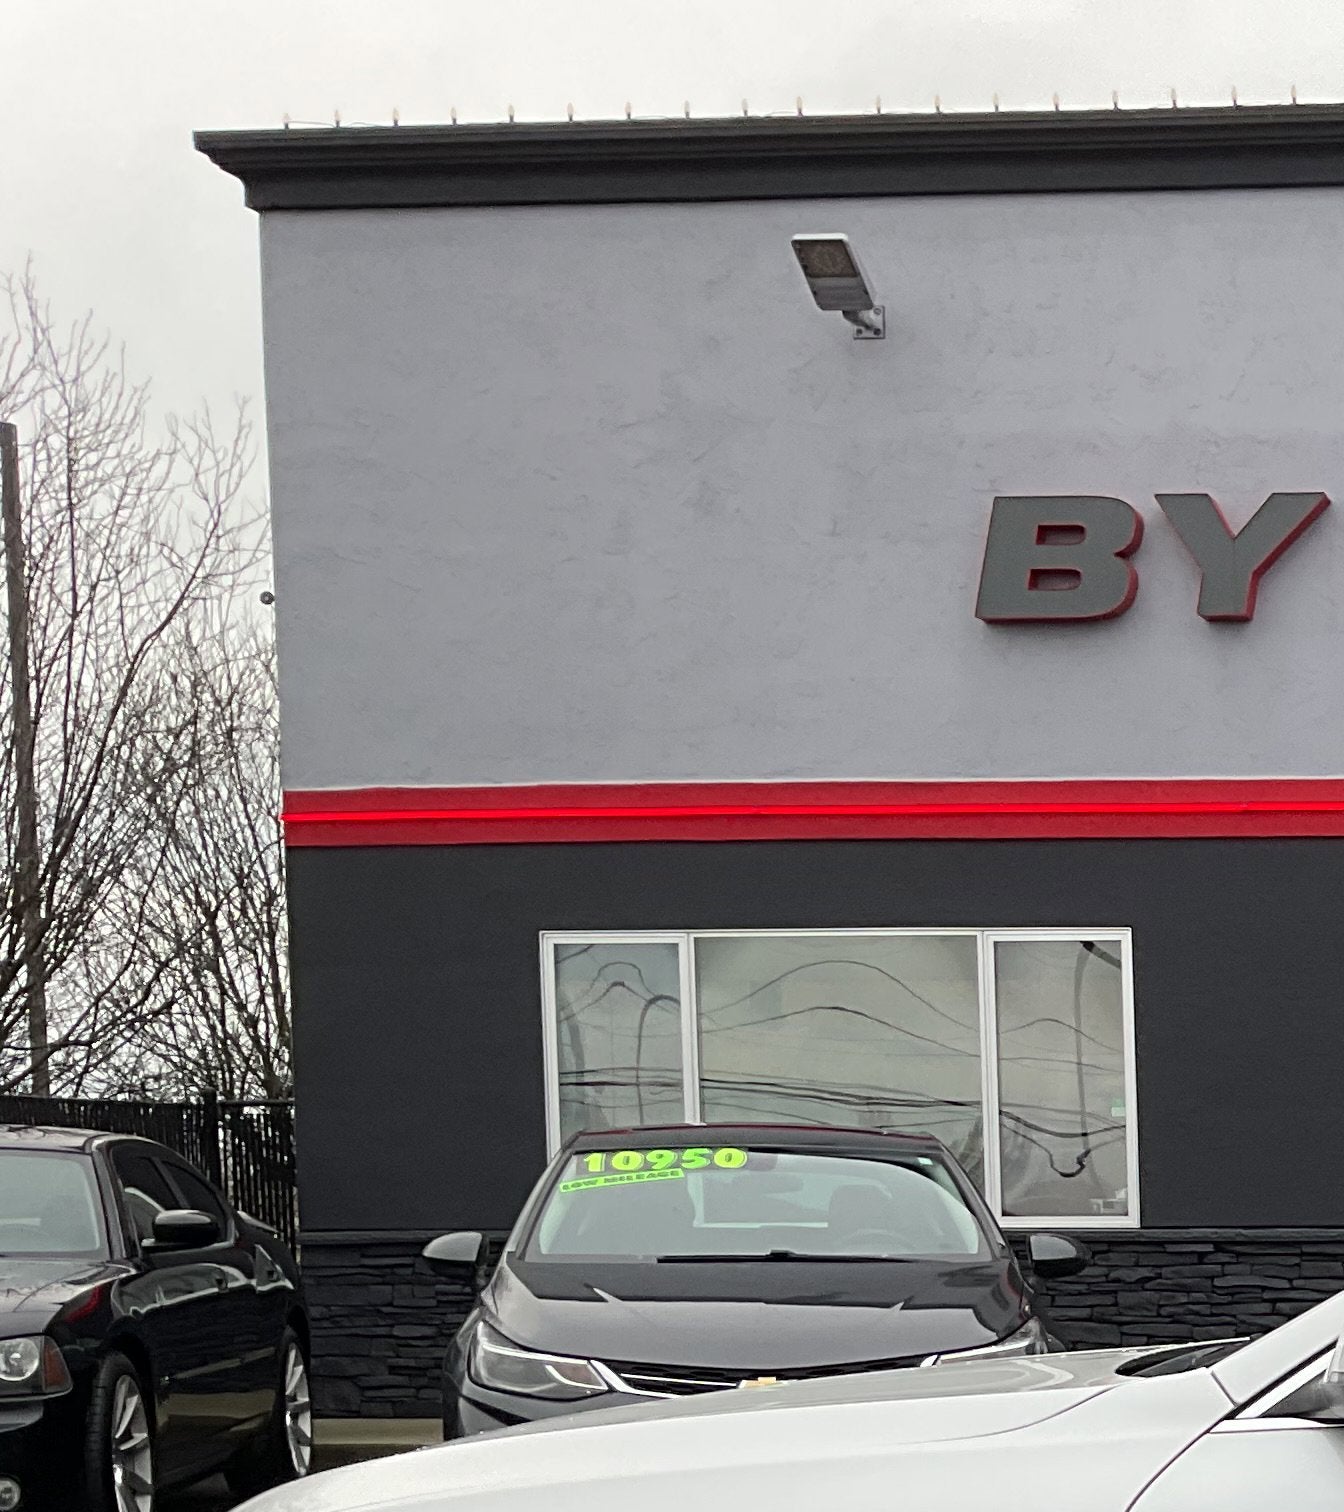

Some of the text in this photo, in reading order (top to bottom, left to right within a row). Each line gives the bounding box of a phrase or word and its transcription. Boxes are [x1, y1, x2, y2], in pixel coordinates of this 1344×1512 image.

[973, 491, 1332, 625] BY
[583, 1147, 748, 1173] 10950
[562, 1170, 680, 1191] LOW MILEAGE
